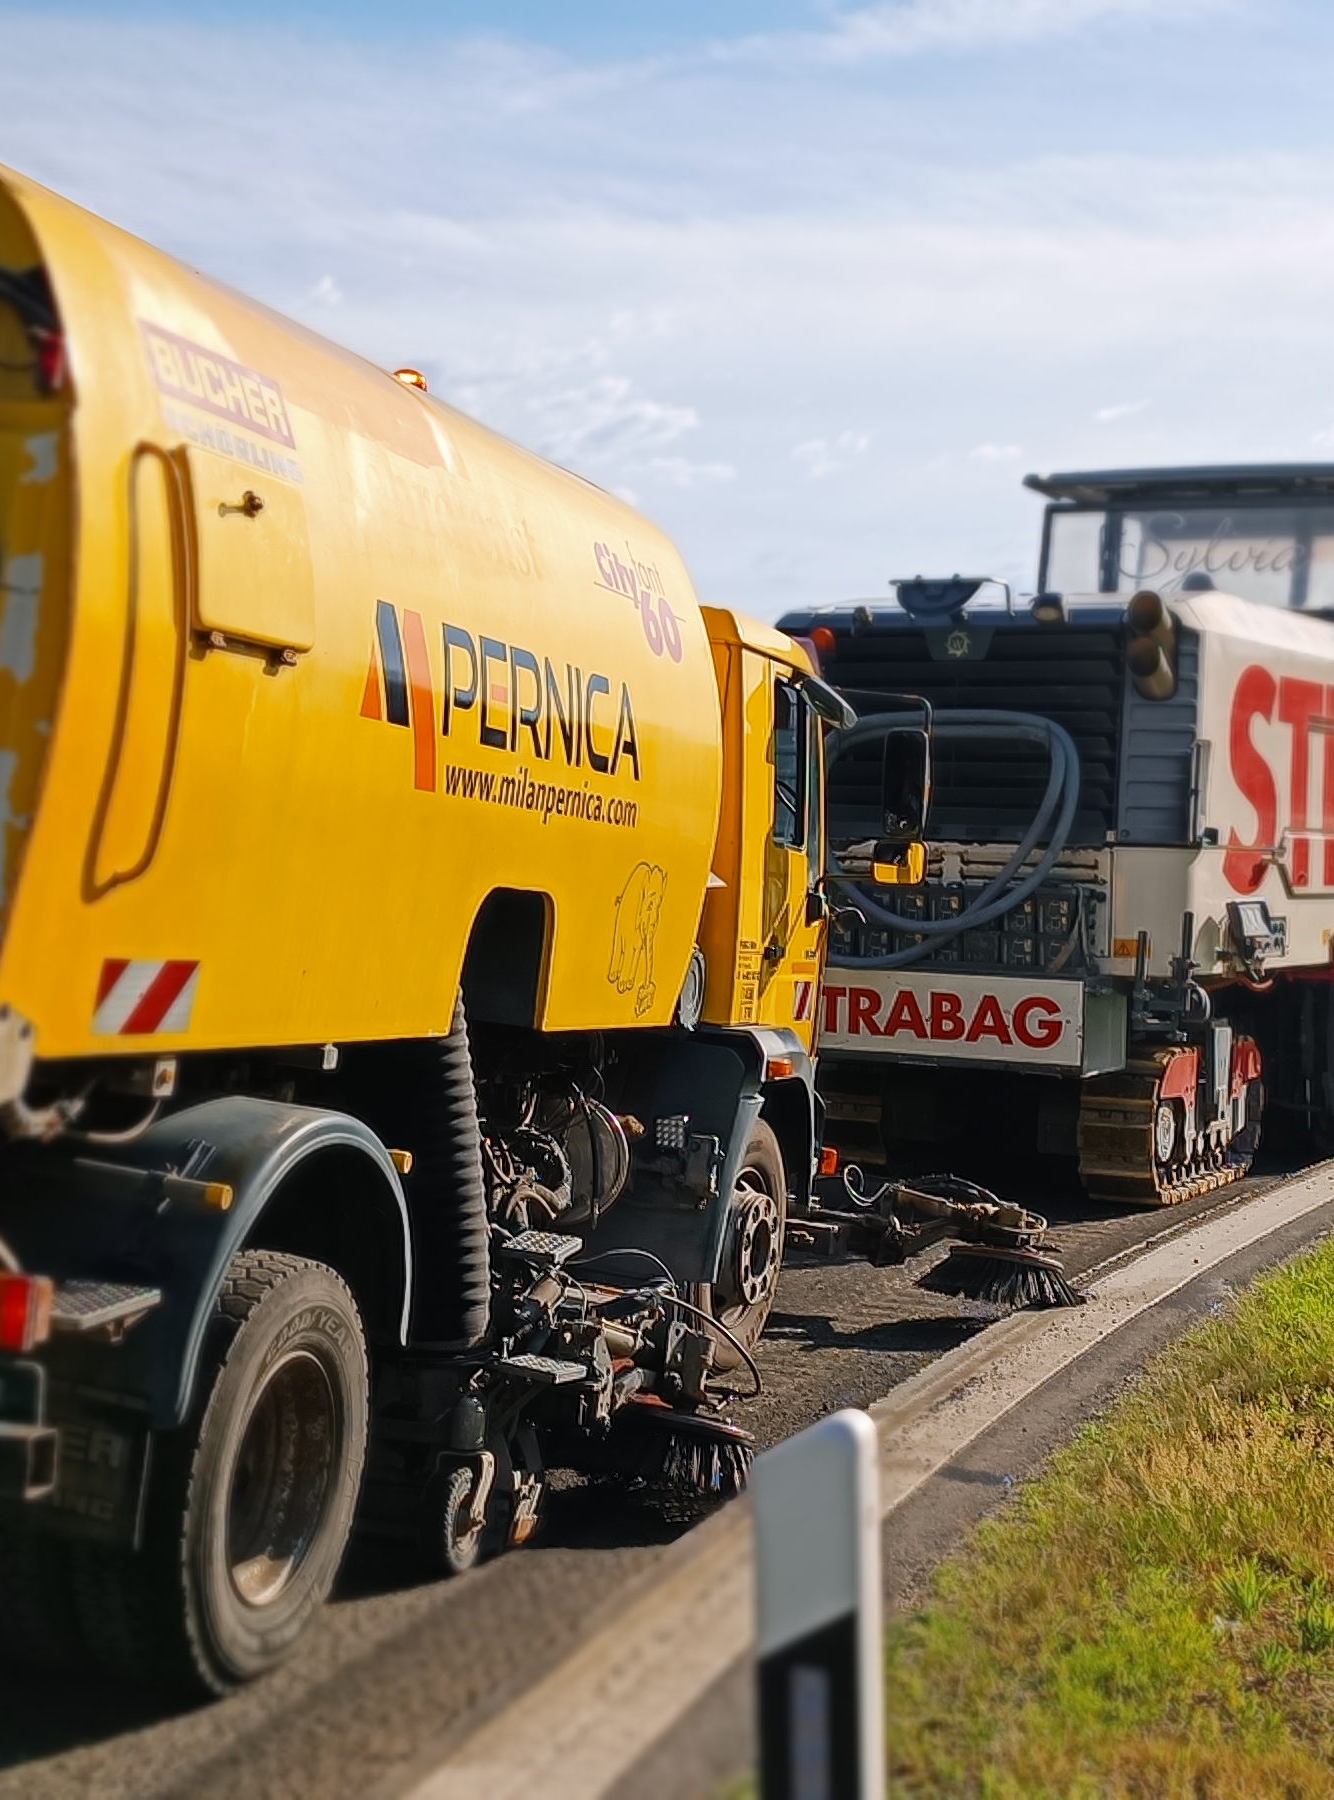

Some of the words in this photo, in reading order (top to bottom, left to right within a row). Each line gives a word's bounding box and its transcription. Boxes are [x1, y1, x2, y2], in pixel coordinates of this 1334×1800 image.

[148, 332, 289, 437] BUCHER
[641, 590, 682, 664] 60
[441, 622, 641, 781] PERNICA
[445, 765, 637, 828] www.milanpernica.com
[822, 985, 1063, 1049] TRABAG
